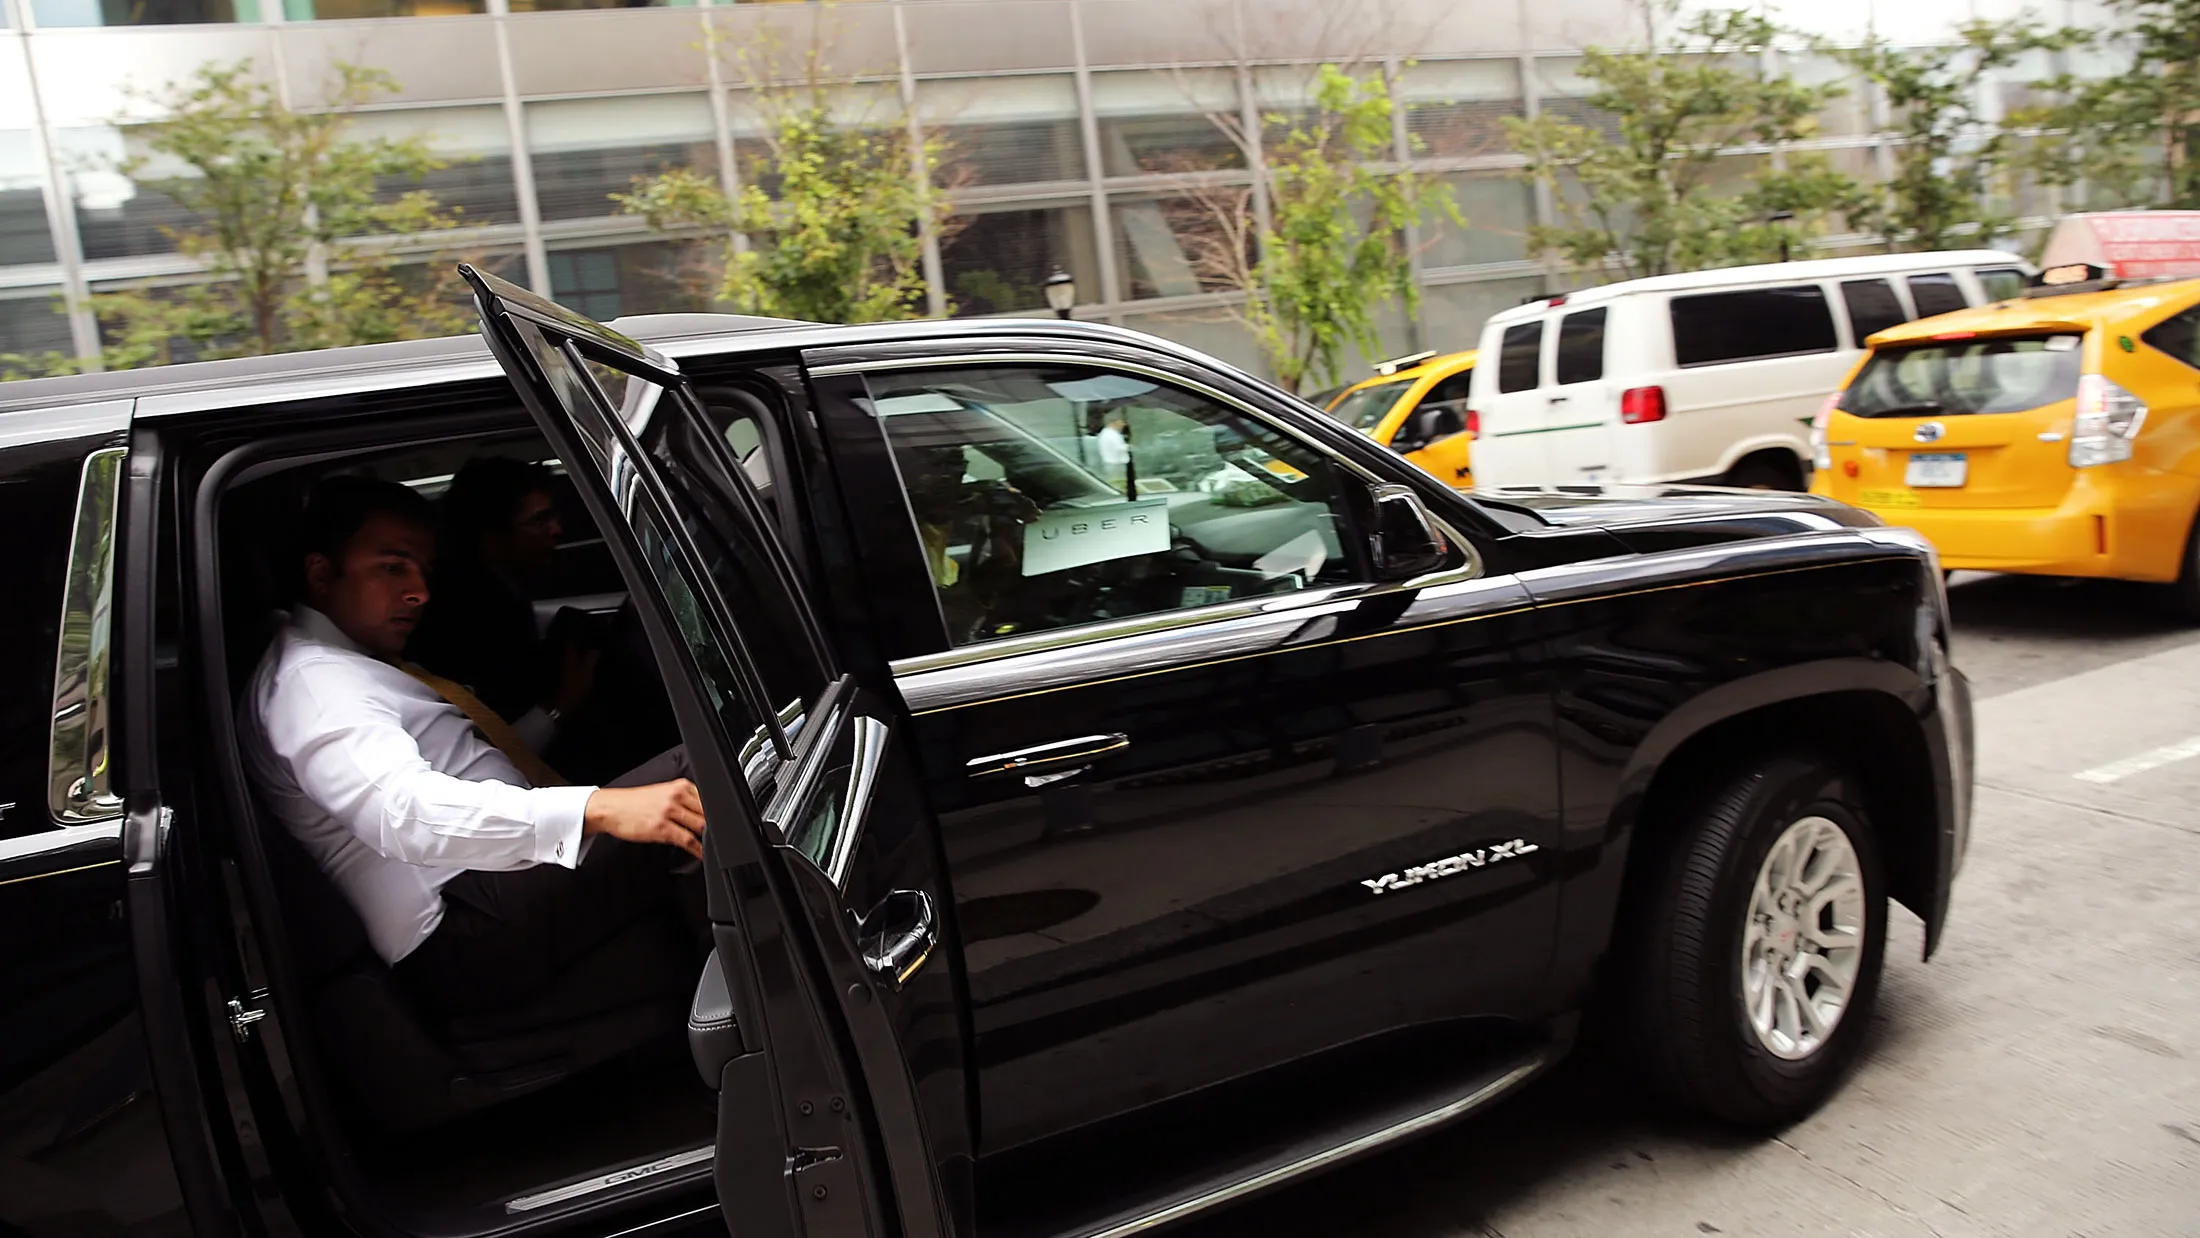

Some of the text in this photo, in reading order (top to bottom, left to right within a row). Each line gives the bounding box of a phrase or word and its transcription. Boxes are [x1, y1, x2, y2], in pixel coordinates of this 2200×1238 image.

[1041, 514, 1149, 540] UBER
[1360, 838, 1539, 895] YUKON XL
[604, 1160, 673, 1185] GMC
